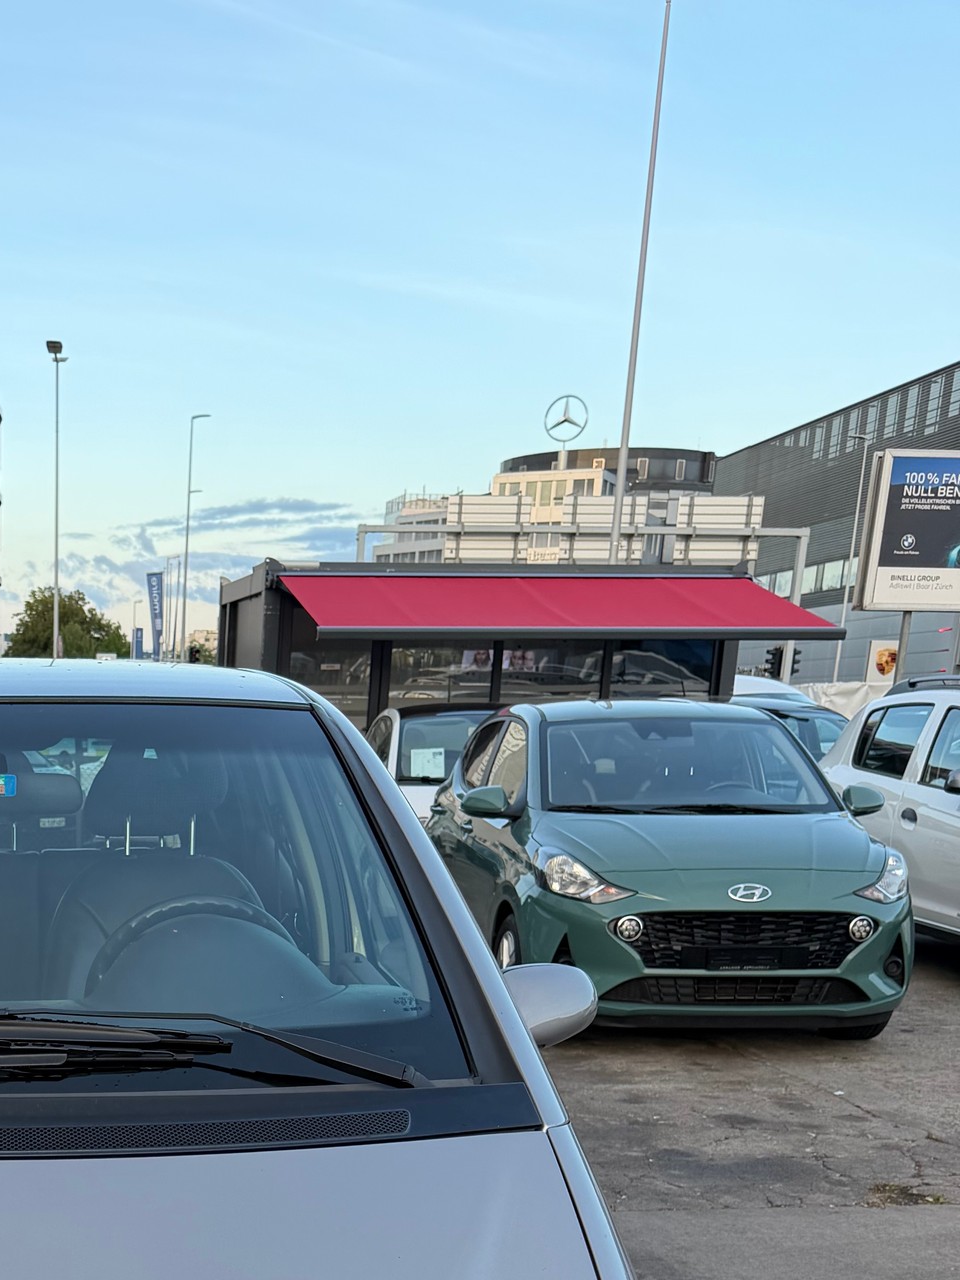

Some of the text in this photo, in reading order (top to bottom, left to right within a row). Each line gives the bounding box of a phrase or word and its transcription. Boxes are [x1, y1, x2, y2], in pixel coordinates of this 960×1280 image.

[905, 472, 960, 485] 100 % FA
[903, 485, 935, 497] NULL
